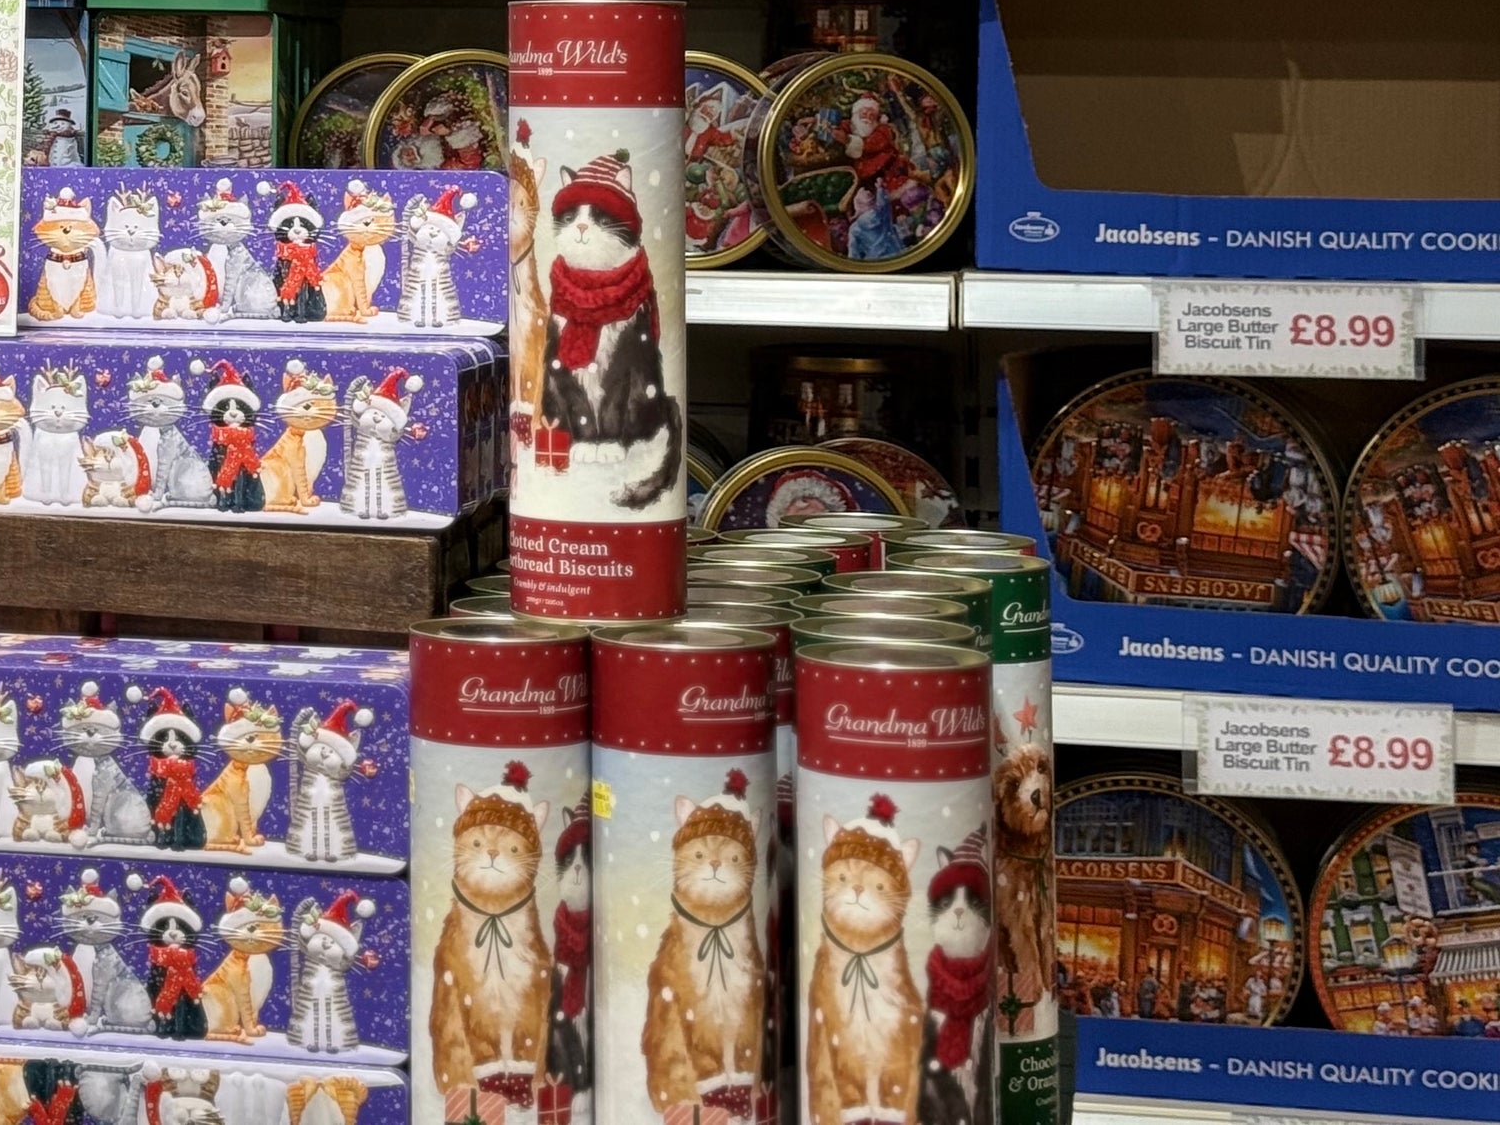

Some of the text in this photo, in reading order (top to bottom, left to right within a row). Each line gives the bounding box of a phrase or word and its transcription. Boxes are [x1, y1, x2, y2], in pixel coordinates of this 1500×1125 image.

[557, 39, 628, 67] Wild's
[1095, 223, 1200, 246] Jacobsens
[1227, 230, 1311, 249] DANISH
[1319, 231, 1411, 251] QUALITY
[1182, 303, 1271, 317] Jacobsens
[1177, 319, 1278, 336] Large Butter
[1290, 314, 1395, 347] £8.99
[1185, 335, 1271, 350] Biscuit Tin
[548, 538, 608, 556] Cream
[559, 559, 633, 577] Biscuits
[538, 582, 547, 591] &
[547, 582, 591, 597] indulgent
[1144, 575, 1266, 600] JACOBSENS
[1119, 636, 1224, 663] Jacobsens
[1250, 647, 1336, 669] DANISH
[1343, 652, 1439, 674] QUALITY
[459, 677, 556, 704] Grandma
[677, 684, 766, 712] Grandma
[825, 703, 985, 736] Grandma Wild's
[1220, 722, 1309, 738] Jacobsens
[1216, 738, 1316, 756] Large Butter
[1328, 735, 1433, 771] £8.99
[1223, 755, 1310, 773] Biscuit Tin
[1058, 861, 1168, 879] ACOBSENS
[1097, 1047, 1202, 1072] Jacobsens
[1227, 1058, 1313, 1080] DANISH
[1320, 1063, 1414, 1086] QUALITY
[1008, 1076, 1025, 1092] &
